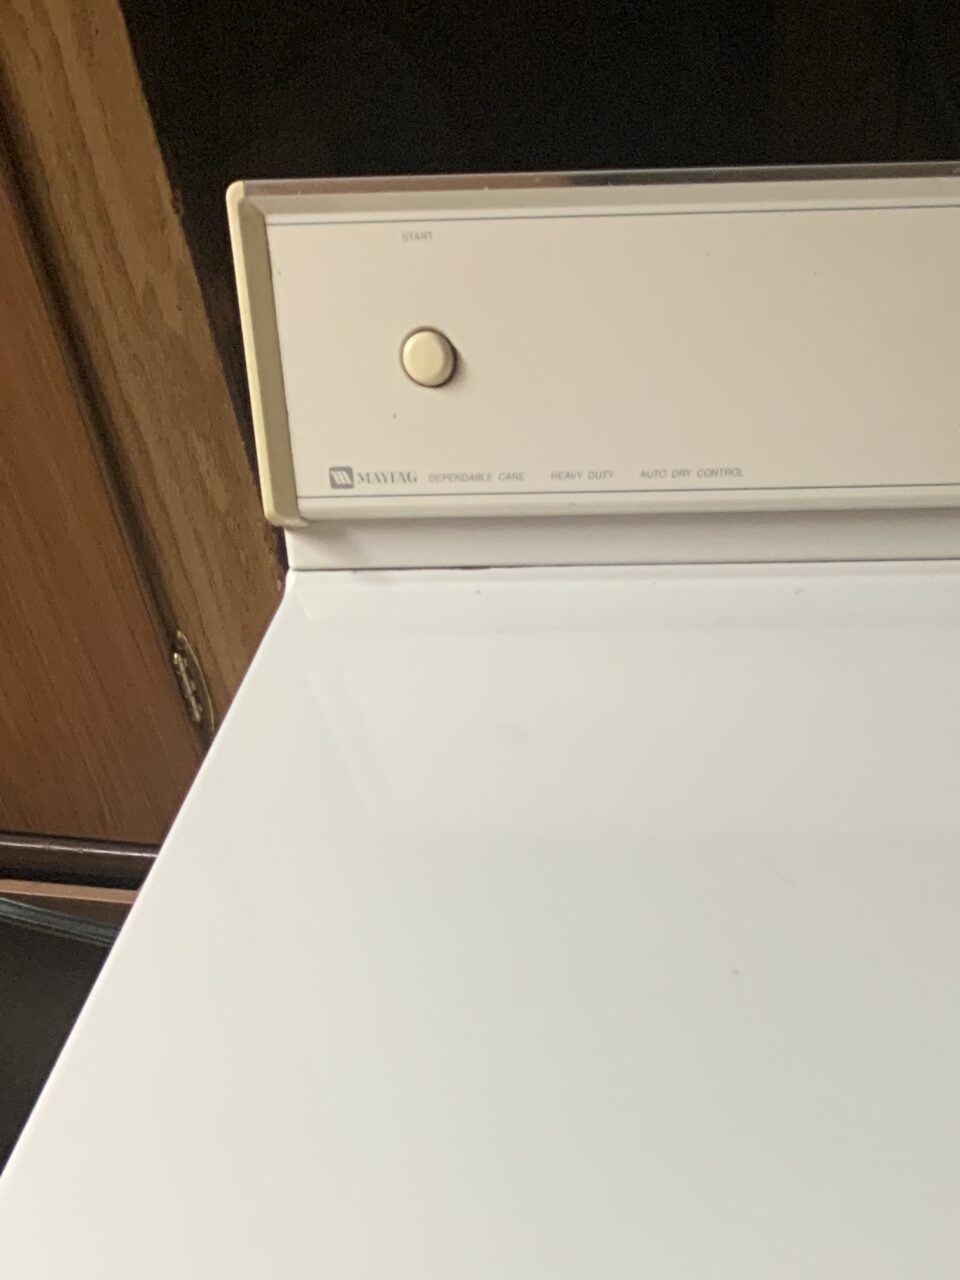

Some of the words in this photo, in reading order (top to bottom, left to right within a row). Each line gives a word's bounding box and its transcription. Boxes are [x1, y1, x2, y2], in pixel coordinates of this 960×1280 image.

[402, 231, 433, 242] START
[357, 471, 418, 484] MAYTAG
[428, 472, 493, 483] DEPENDABLE
[498, 471, 525, 482] CARE
[550, 471, 583, 481] HEAVY
[588, 470, 615, 480] DUTY
[640, 469, 667, 479] AUTO
[671, 468, 692, 478] DRY
[697, 467, 744, 478] CONTROL
